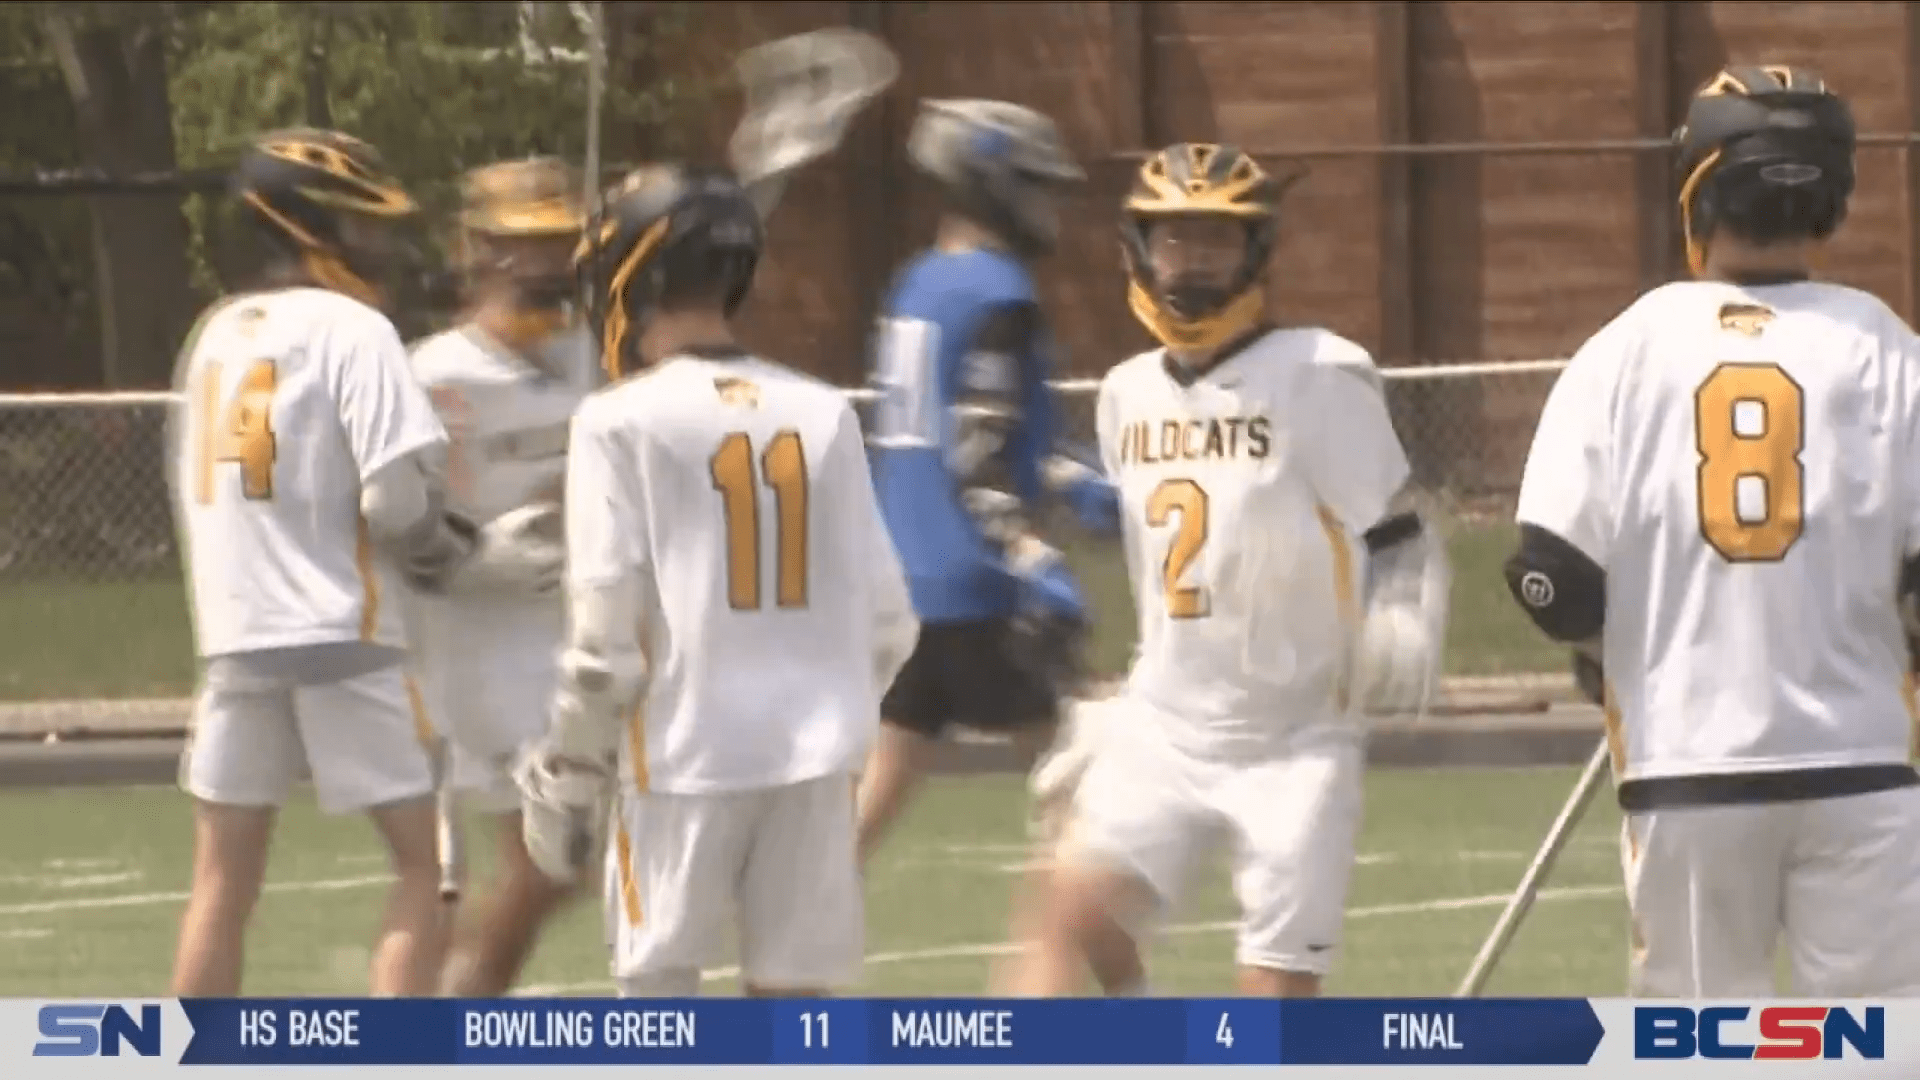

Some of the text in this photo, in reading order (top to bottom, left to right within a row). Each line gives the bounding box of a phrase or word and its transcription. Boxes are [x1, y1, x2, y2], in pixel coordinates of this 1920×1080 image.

[197, 358, 275, 502] 14
[1695, 361, 1805, 563] 8
[711, 430, 809, 610] 11
[1145, 477, 1211, 619] 2
